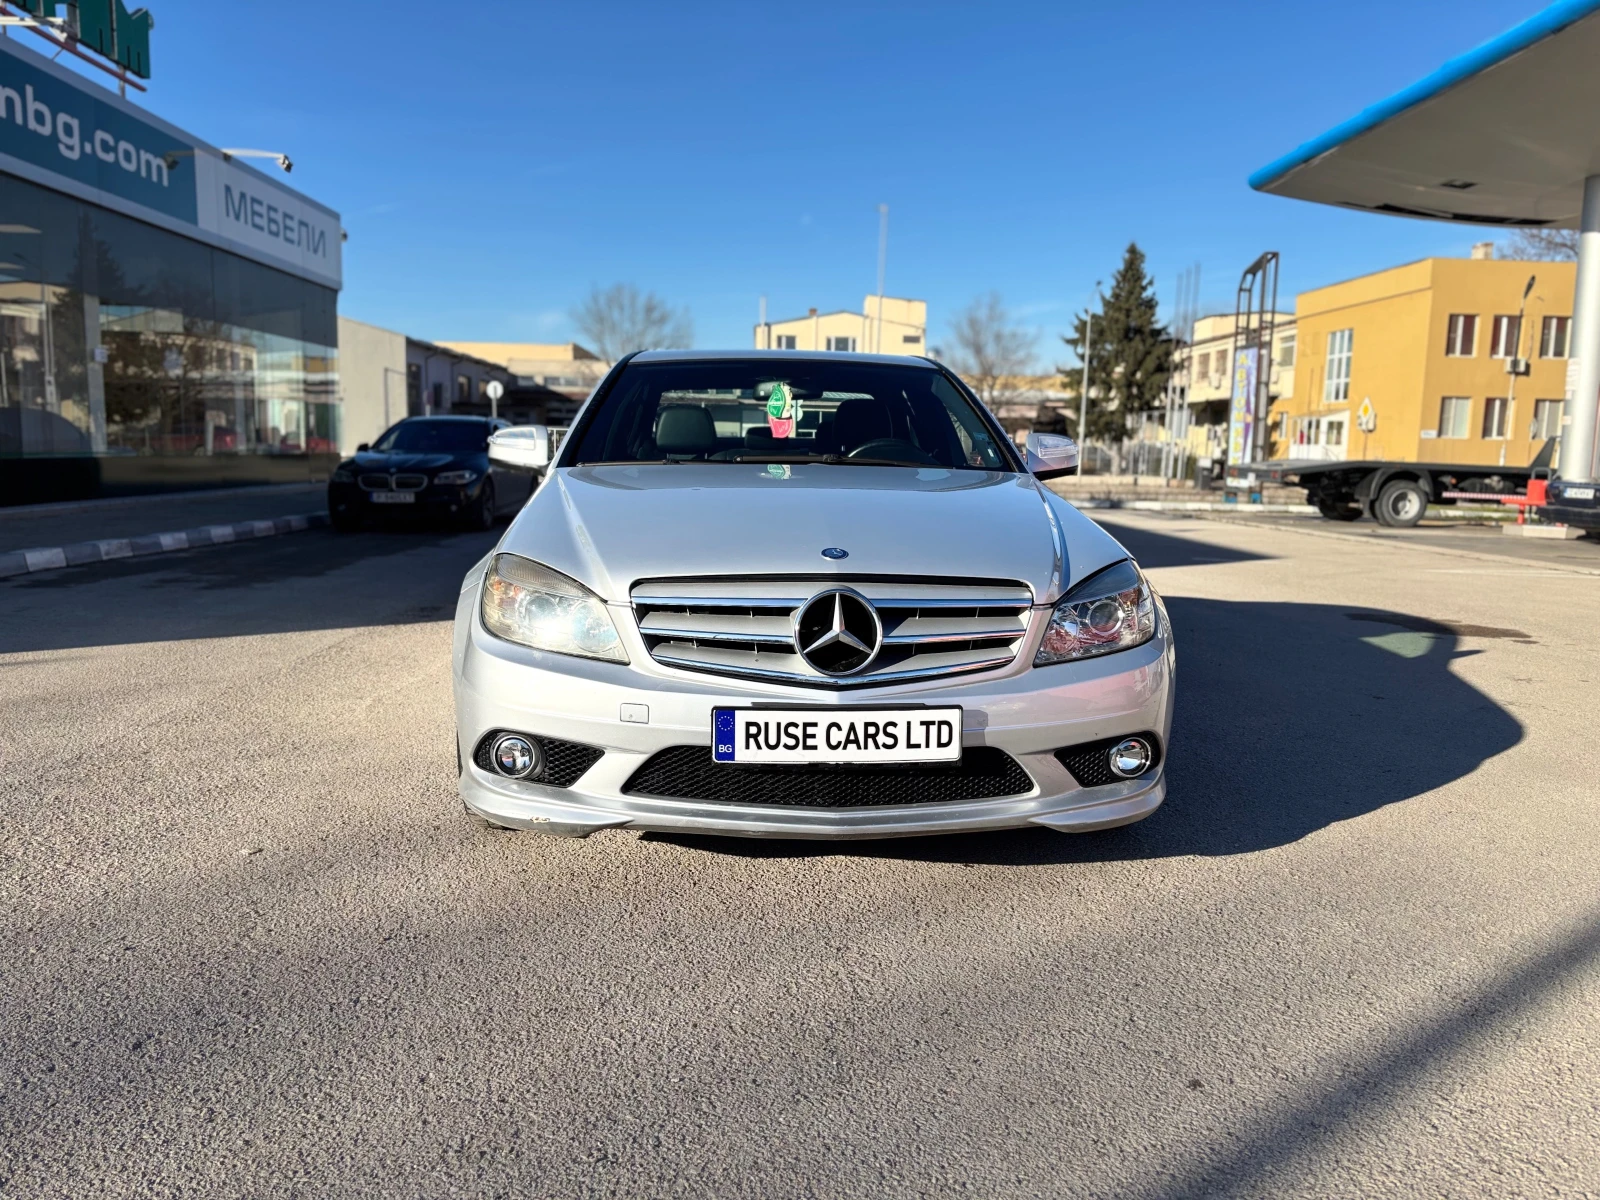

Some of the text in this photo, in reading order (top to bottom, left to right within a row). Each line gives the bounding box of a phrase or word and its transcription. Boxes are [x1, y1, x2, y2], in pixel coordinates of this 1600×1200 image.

[224, 184, 326, 258] МЕБЕЛИ
[718, 744, 733, 753] BG
[745, 720, 954, 751] RUSE CARS LTD
